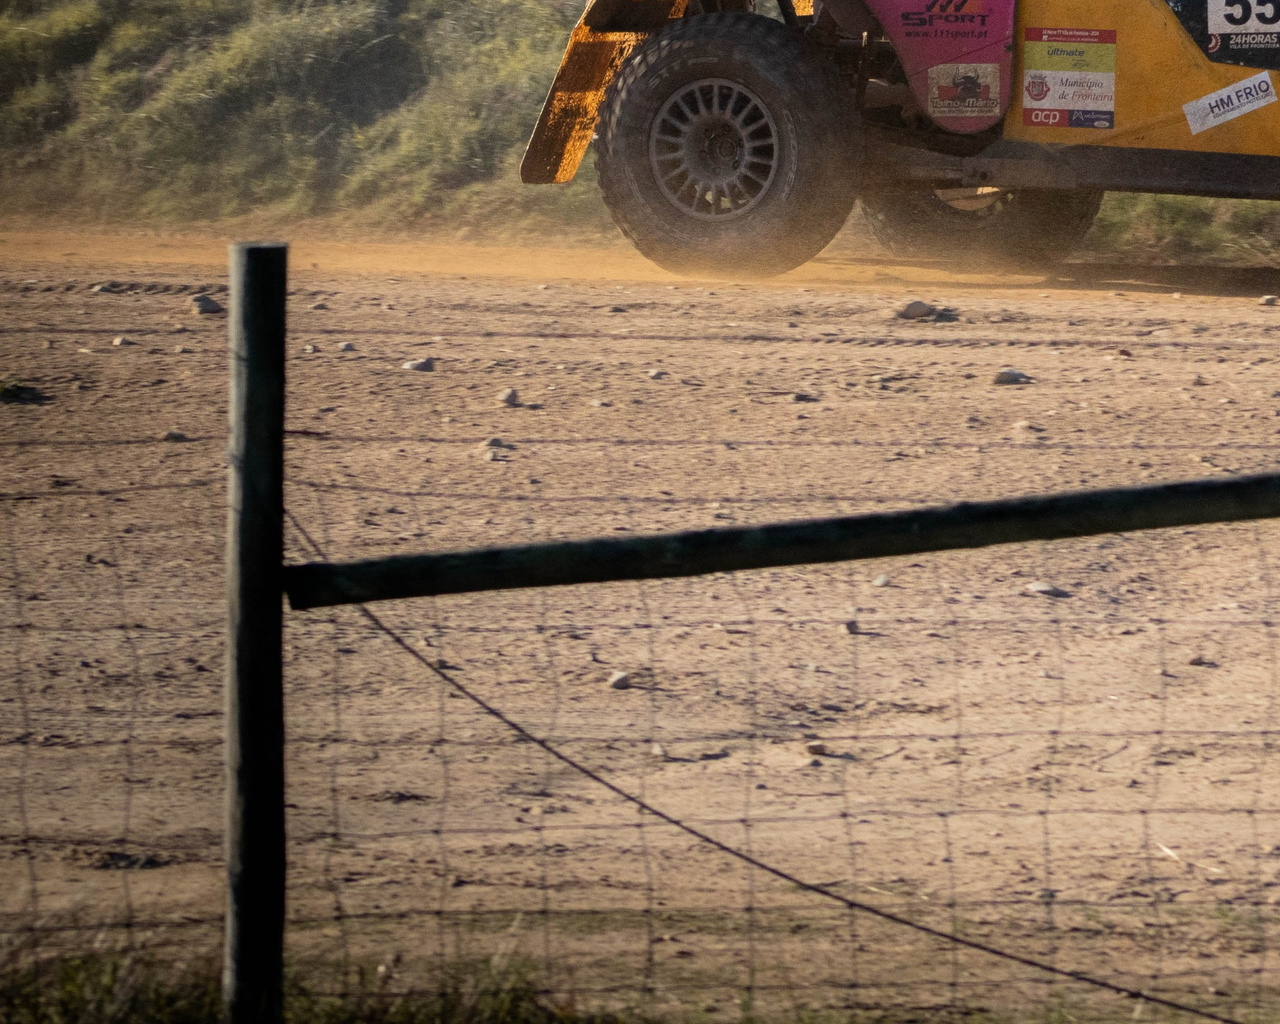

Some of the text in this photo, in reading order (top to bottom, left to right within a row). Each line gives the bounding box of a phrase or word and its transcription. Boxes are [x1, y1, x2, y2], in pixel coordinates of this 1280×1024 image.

[901, 11, 990, 26] SPORT
[1059, 78, 1103, 90] Município
[1058, 90, 1113, 101] de Fronteira
[1208, 80, 1270, 114] HM FRIO
[1031, 110, 1060, 125] acp
